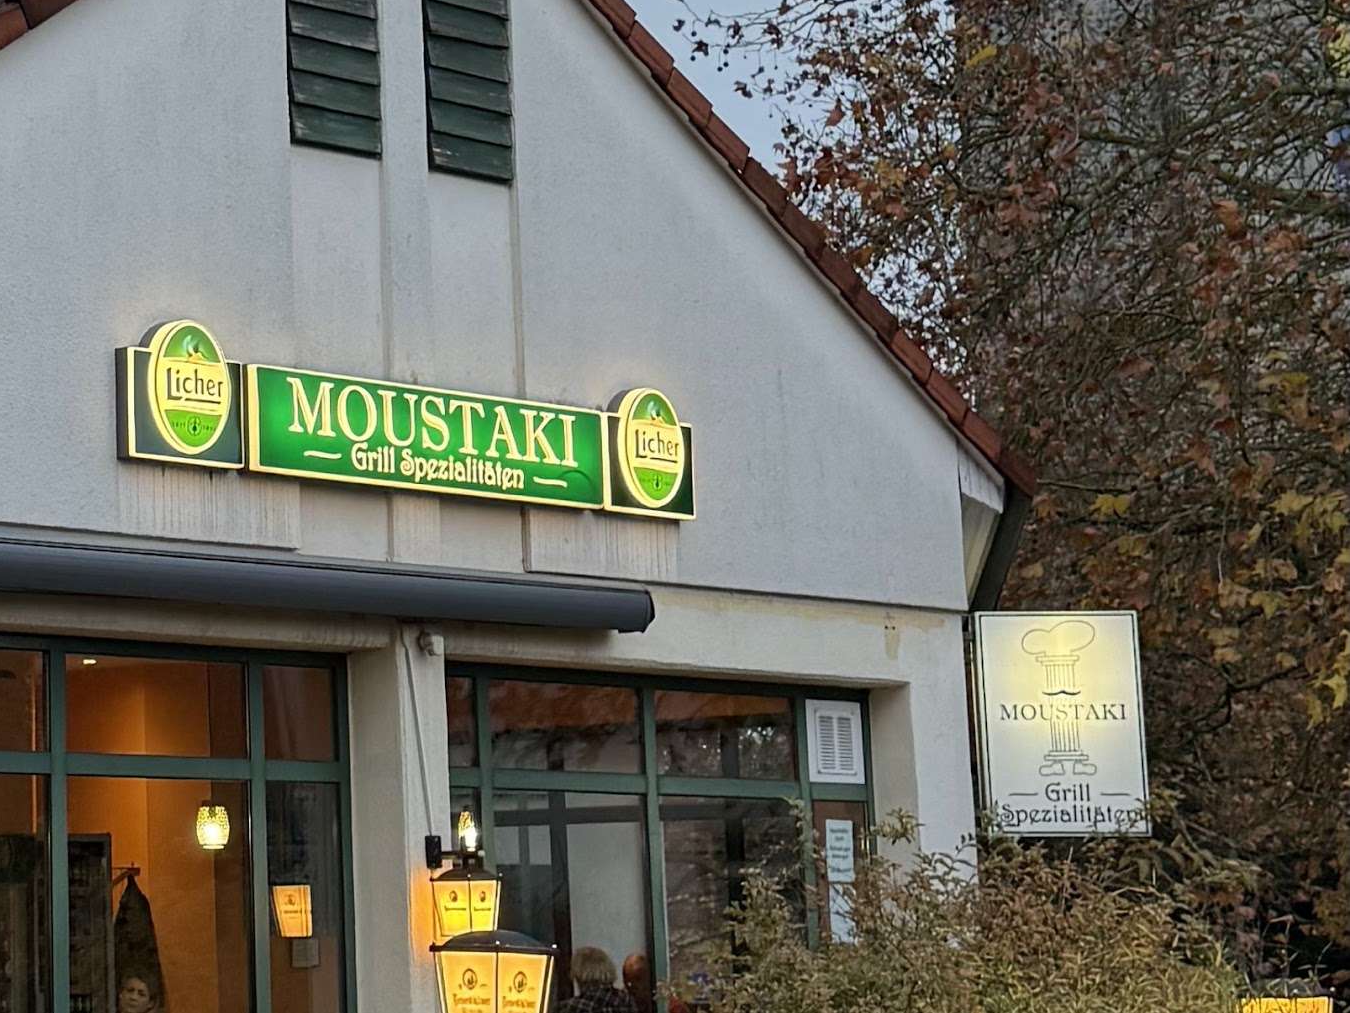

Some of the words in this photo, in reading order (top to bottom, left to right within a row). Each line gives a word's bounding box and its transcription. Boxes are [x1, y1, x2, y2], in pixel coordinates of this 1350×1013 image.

[166, 367, 224, 401] Licher
[286, 376, 579, 468] MOUSTAKI
[634, 429, 680, 459] Licher
[351, 441, 396, 473] Grill
[400, 448, 525, 490] Spezialitäten
[1000, 703, 1127, 722] MOUSTAKI
[1045, 782, 1091, 803] Grill
